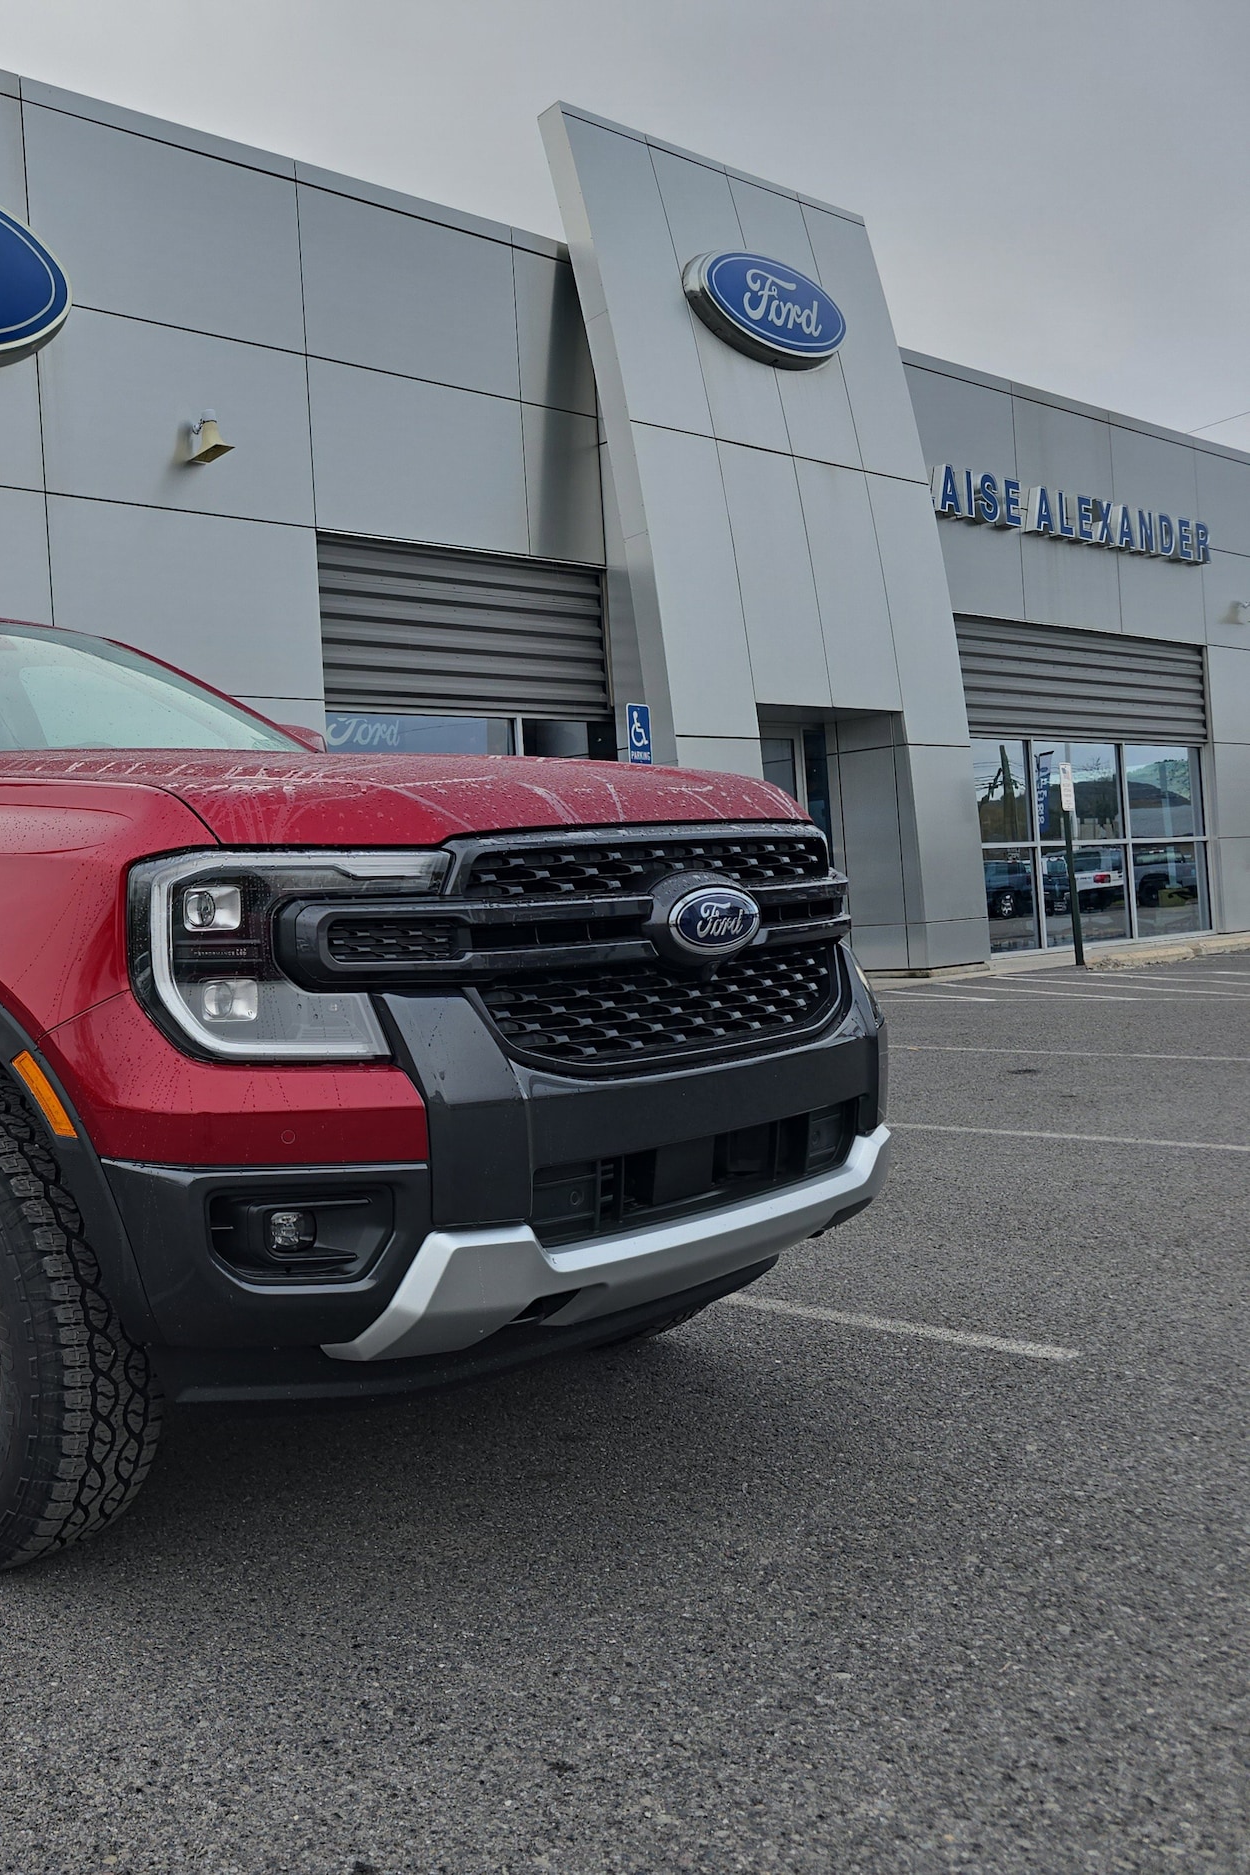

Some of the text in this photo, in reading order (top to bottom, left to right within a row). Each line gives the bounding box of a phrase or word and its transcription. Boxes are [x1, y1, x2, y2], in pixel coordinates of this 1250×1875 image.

[743, 268, 823, 338] Ford
[931, 463, 1212, 564] AISE ALEXANDER
[631, 750, 651, 761] PARKING
[696, 901, 744, 939] Ford
